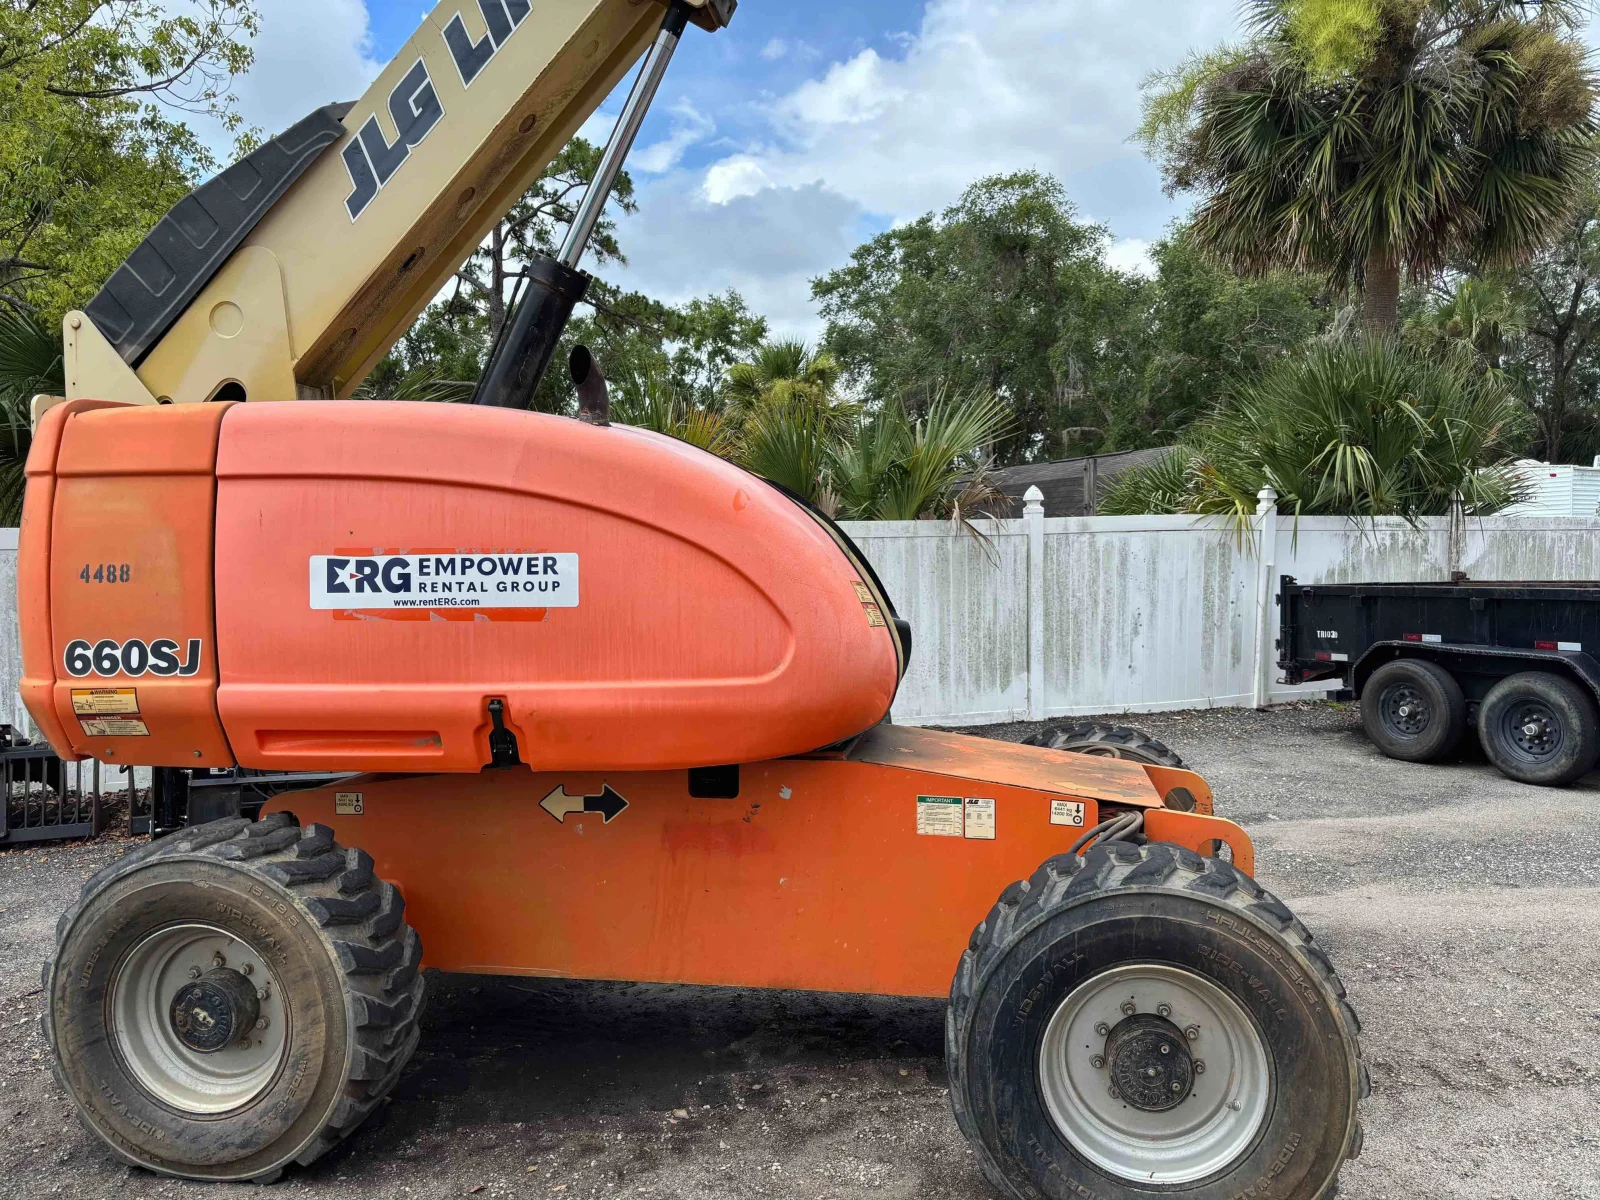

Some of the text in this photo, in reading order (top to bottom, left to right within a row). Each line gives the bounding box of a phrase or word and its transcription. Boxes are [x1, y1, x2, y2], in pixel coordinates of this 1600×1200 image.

[339, 56, 446, 224] JLG
[80, 563, 131, 584] 4488
[326, 557, 412, 594] ERG
[418, 556, 559, 577] EMPOWER
[418, 580, 561, 593] RENTAL GROUP
[393, 597, 481, 607] www.rentERG.com
[63, 638, 202, 678] 660SJ
